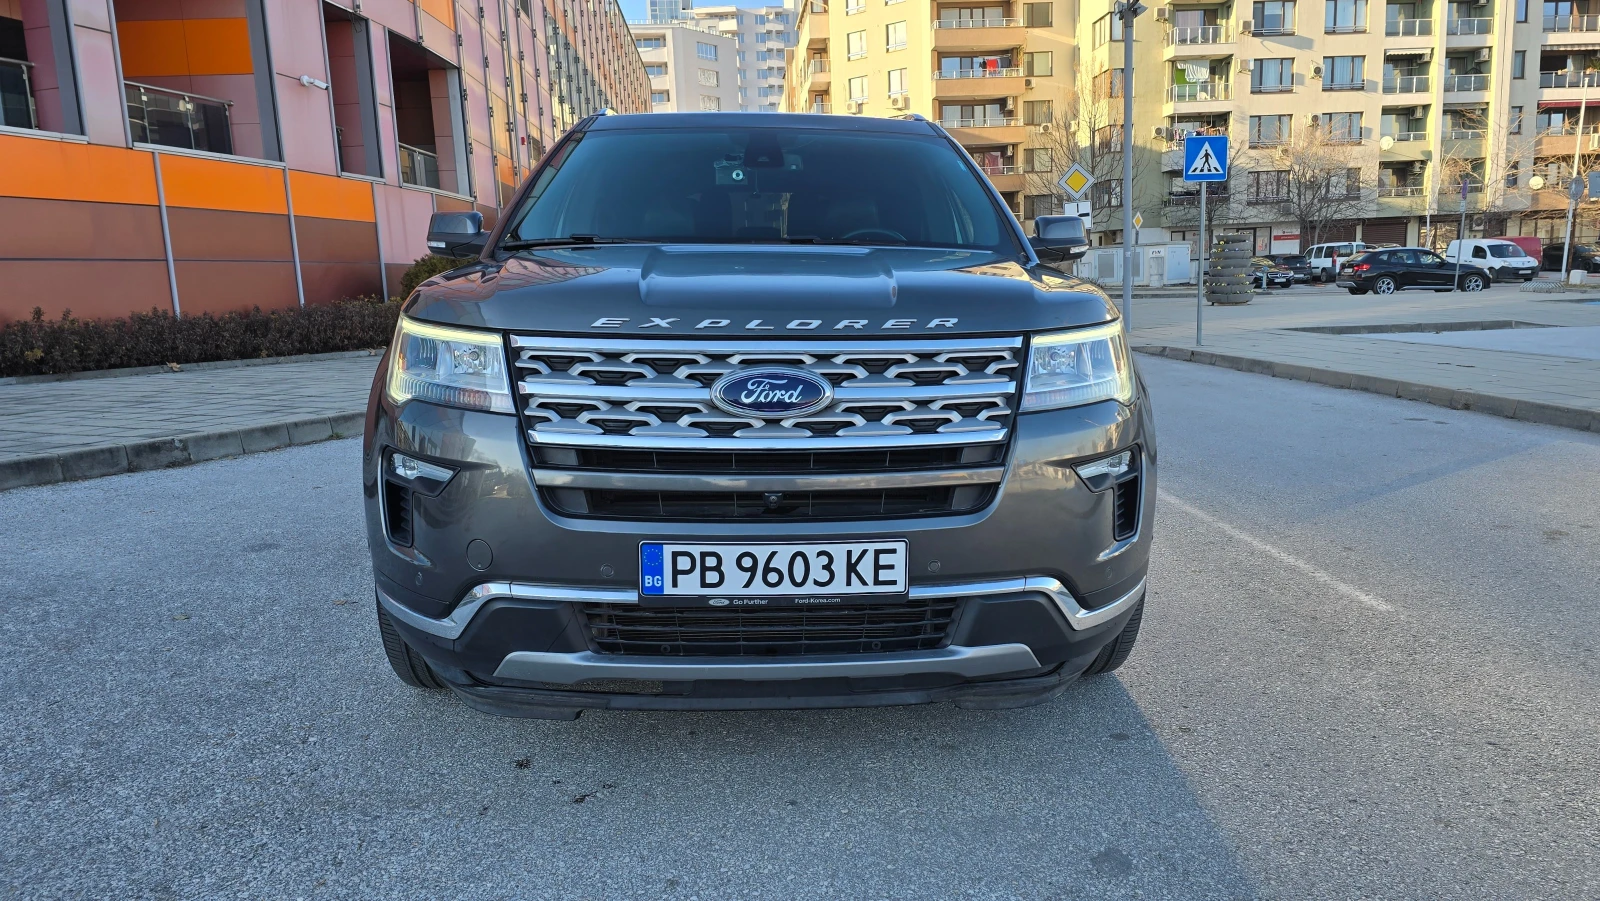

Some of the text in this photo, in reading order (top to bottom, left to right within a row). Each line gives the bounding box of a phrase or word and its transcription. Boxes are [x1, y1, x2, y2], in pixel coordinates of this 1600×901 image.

[590, 317, 959, 330] EXPLORER
[740, 378, 804, 403] Ford
[670, 548, 898, 588] PB 9603 KE
[644, 575, 662, 587] BG
